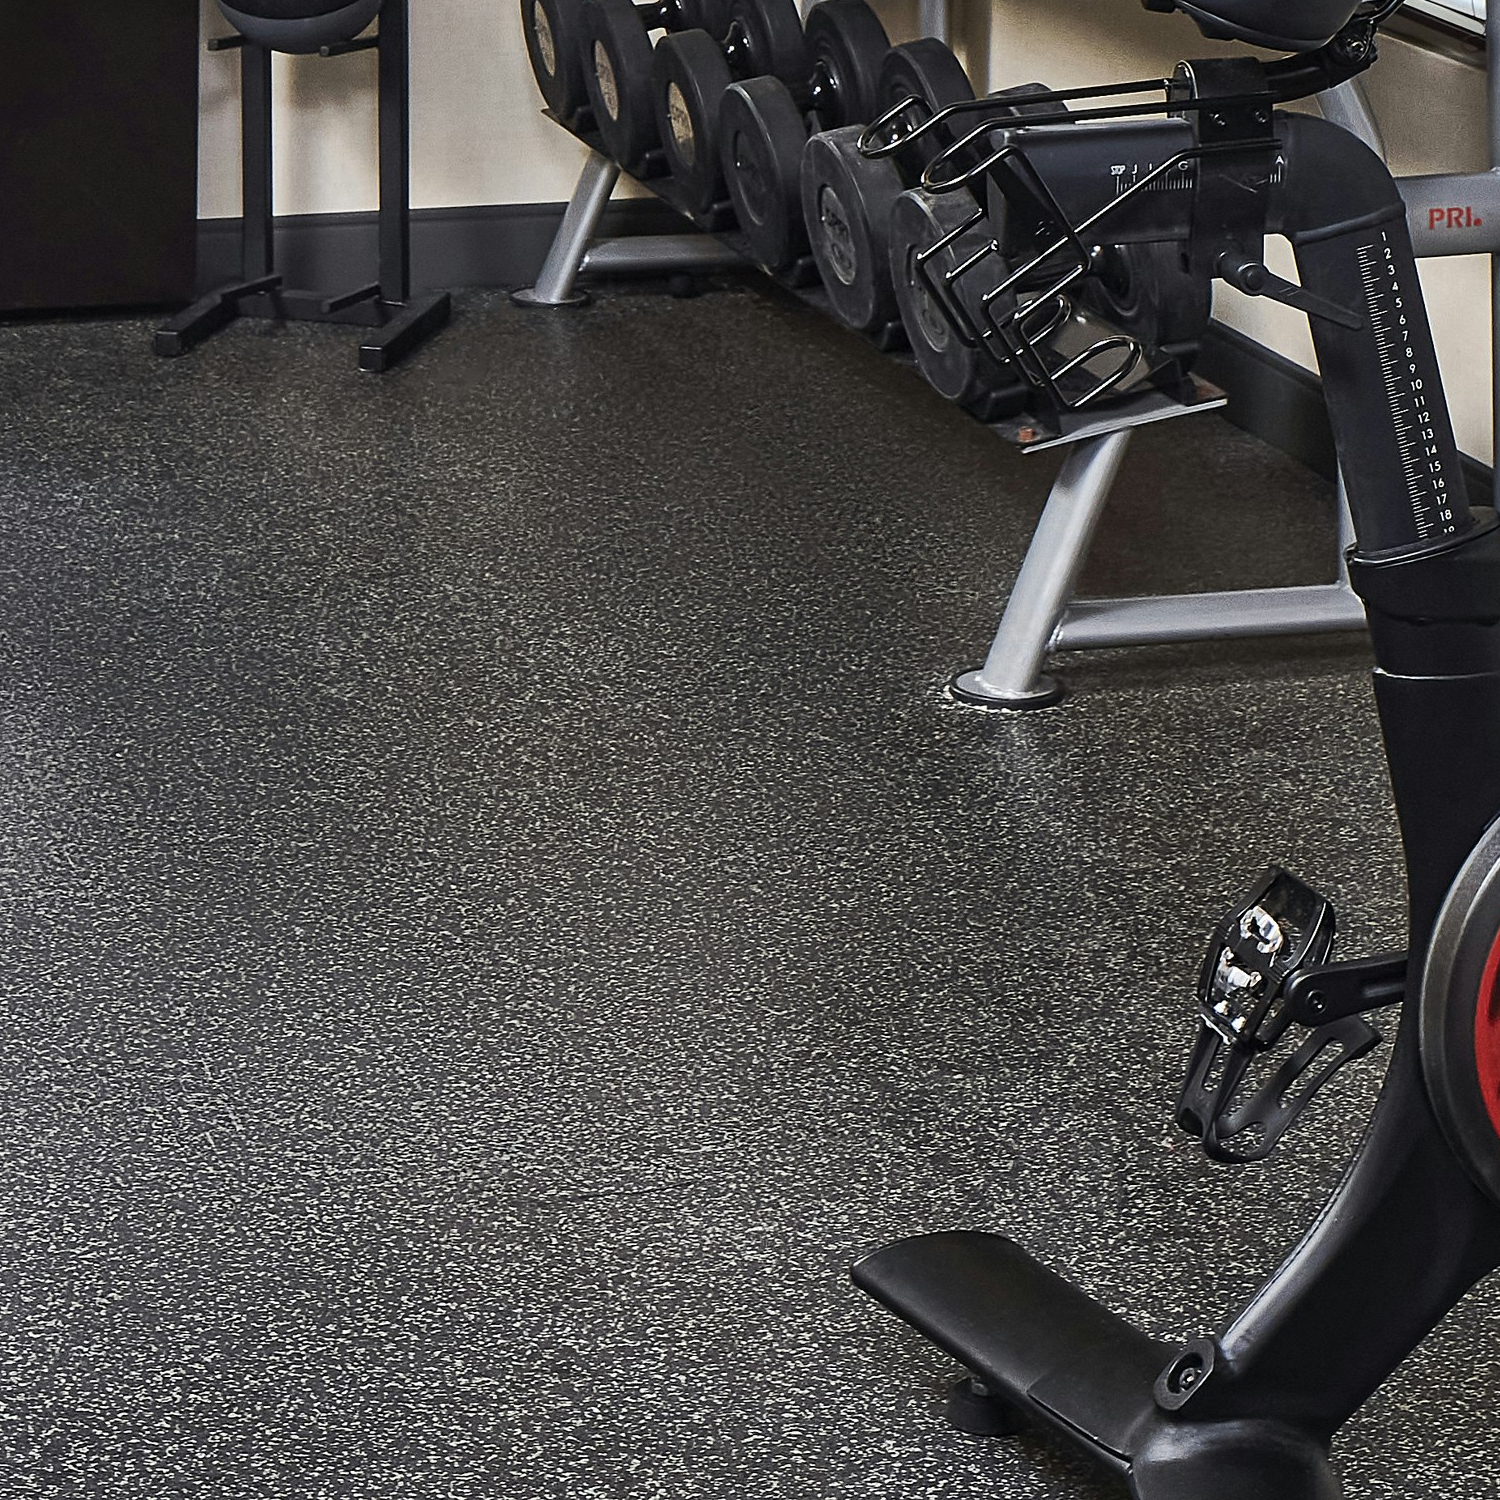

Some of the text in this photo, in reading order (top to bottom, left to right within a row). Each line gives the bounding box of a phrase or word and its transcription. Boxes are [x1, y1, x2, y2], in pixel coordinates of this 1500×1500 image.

[1178, 161, 1189, 171] G
[1275, 155, 1285, 164] A
[1384, 248, 1392, 259] 2
[1387, 265, 1395, 275] 3
[1392, 282, 1399, 291] 4
[1395, 297, 1402, 308] 5
[1399, 314, 1406, 325] 6
[1402, 331, 1408, 341] 7
[1405, 347, 1413, 357] 8
[1409, 364, 1416, 373] 9
[1411, 379, 1423, 391] 10
[1414, 396, 1425, 407] 11
[1418, 411, 1430, 424] 12
[1421, 428, 1434, 440] 13
[1425, 444, 1437, 456] 14
[1429, 461, 1441, 473] 15
[1432, 477, 1445, 489] 16
[1436, 493, 1447, 505] 17
[1440, 509, 1452, 521] 18
